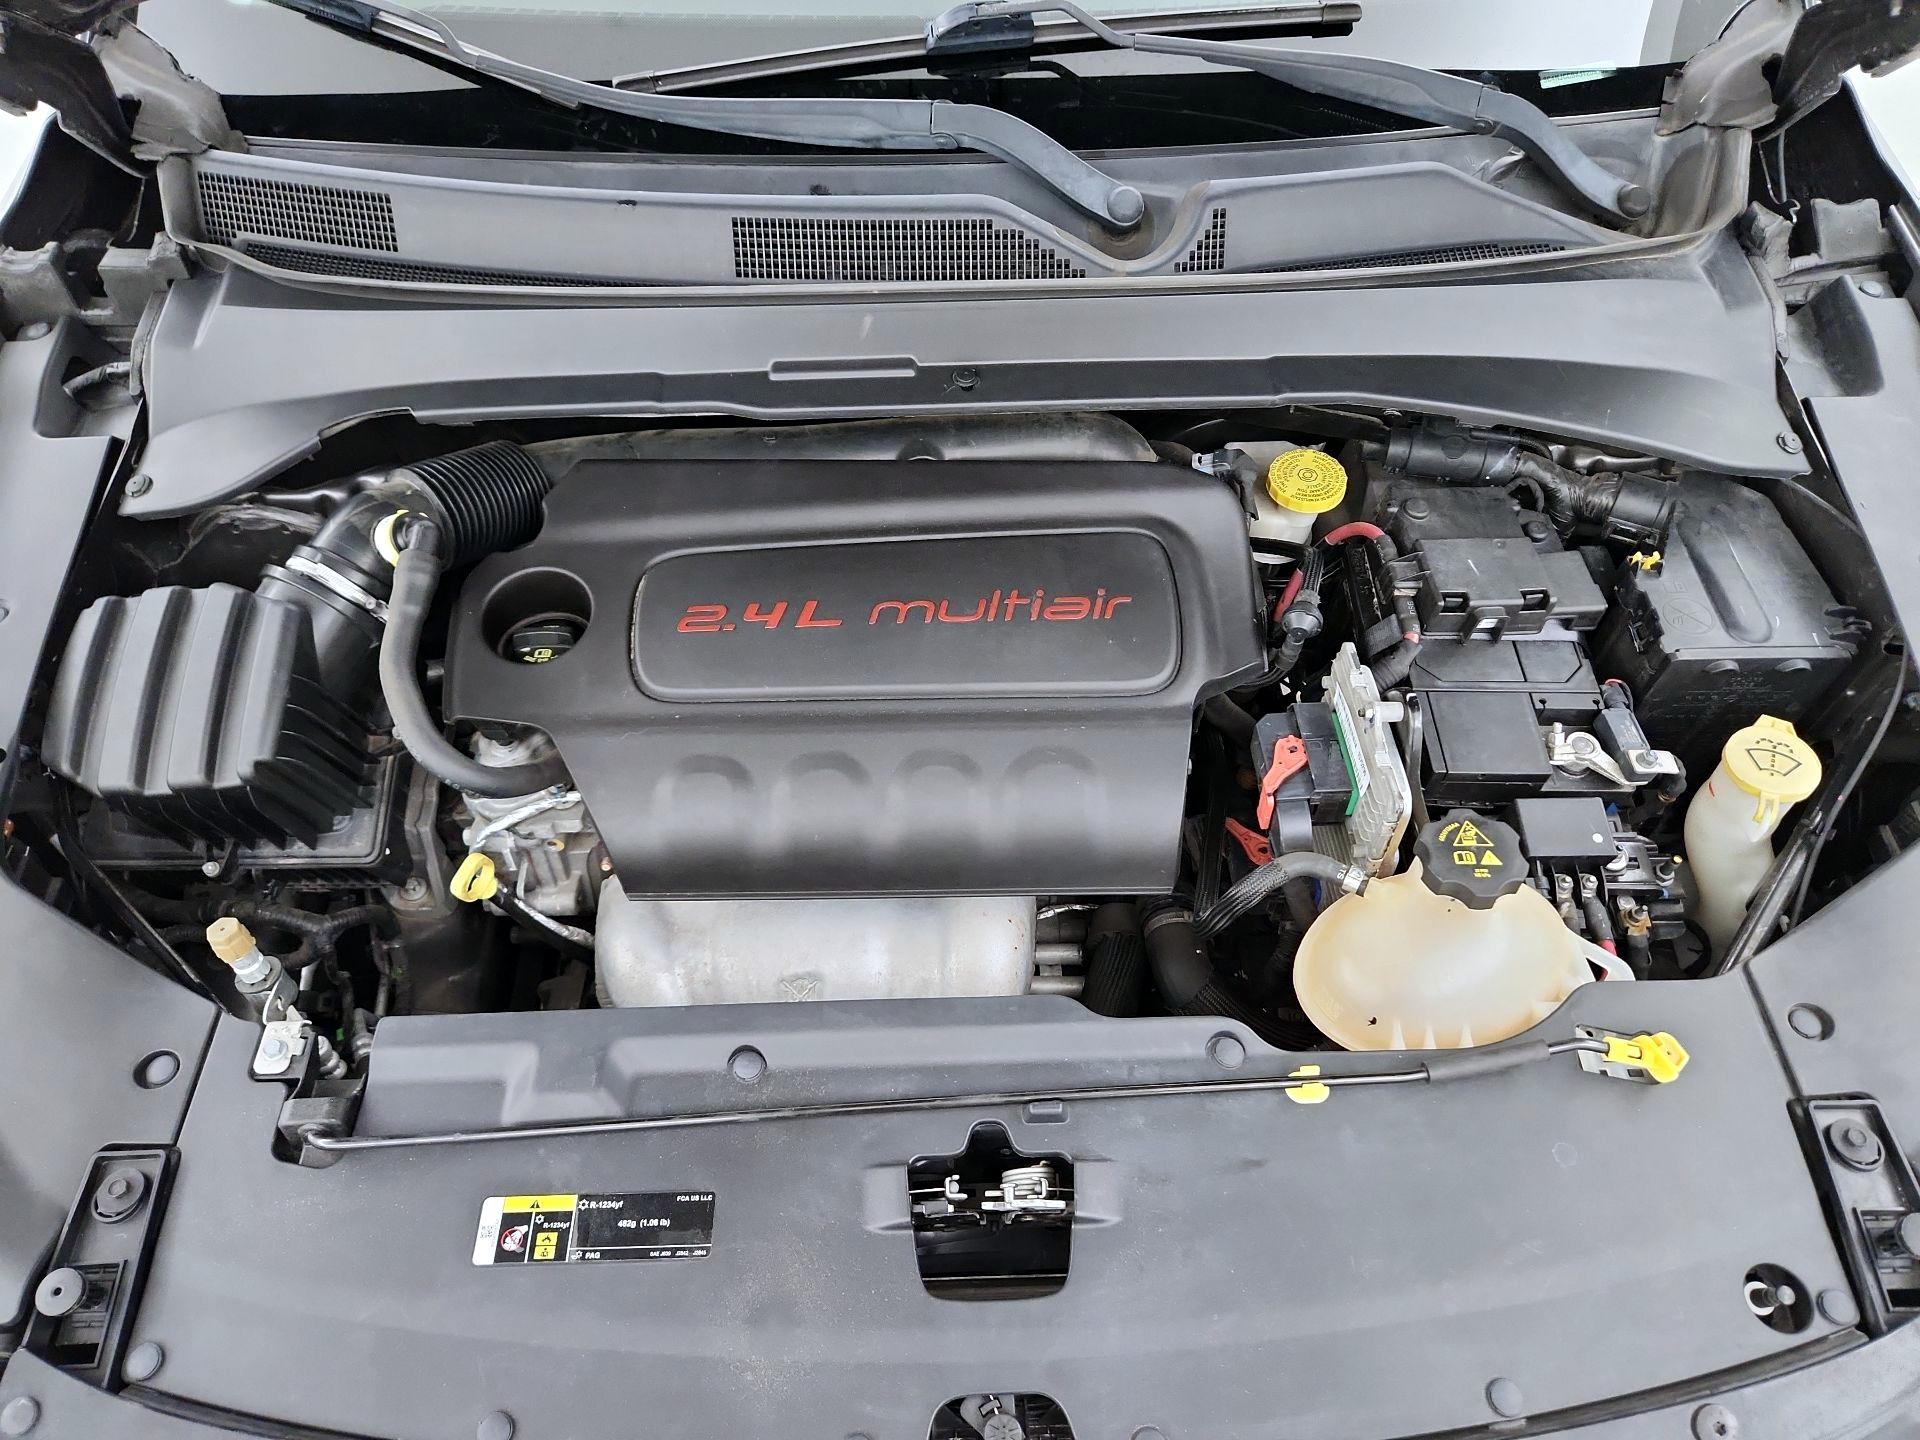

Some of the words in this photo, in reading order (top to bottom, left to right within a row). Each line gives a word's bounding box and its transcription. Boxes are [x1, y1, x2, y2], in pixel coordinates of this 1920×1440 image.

[868, 588, 1132, 625] multiair
[589, 1200, 623, 1210] R-1234yf
[542, 1222, 571, 1230] R-1234yf
[660, 1219, 670, 1227] lb)
